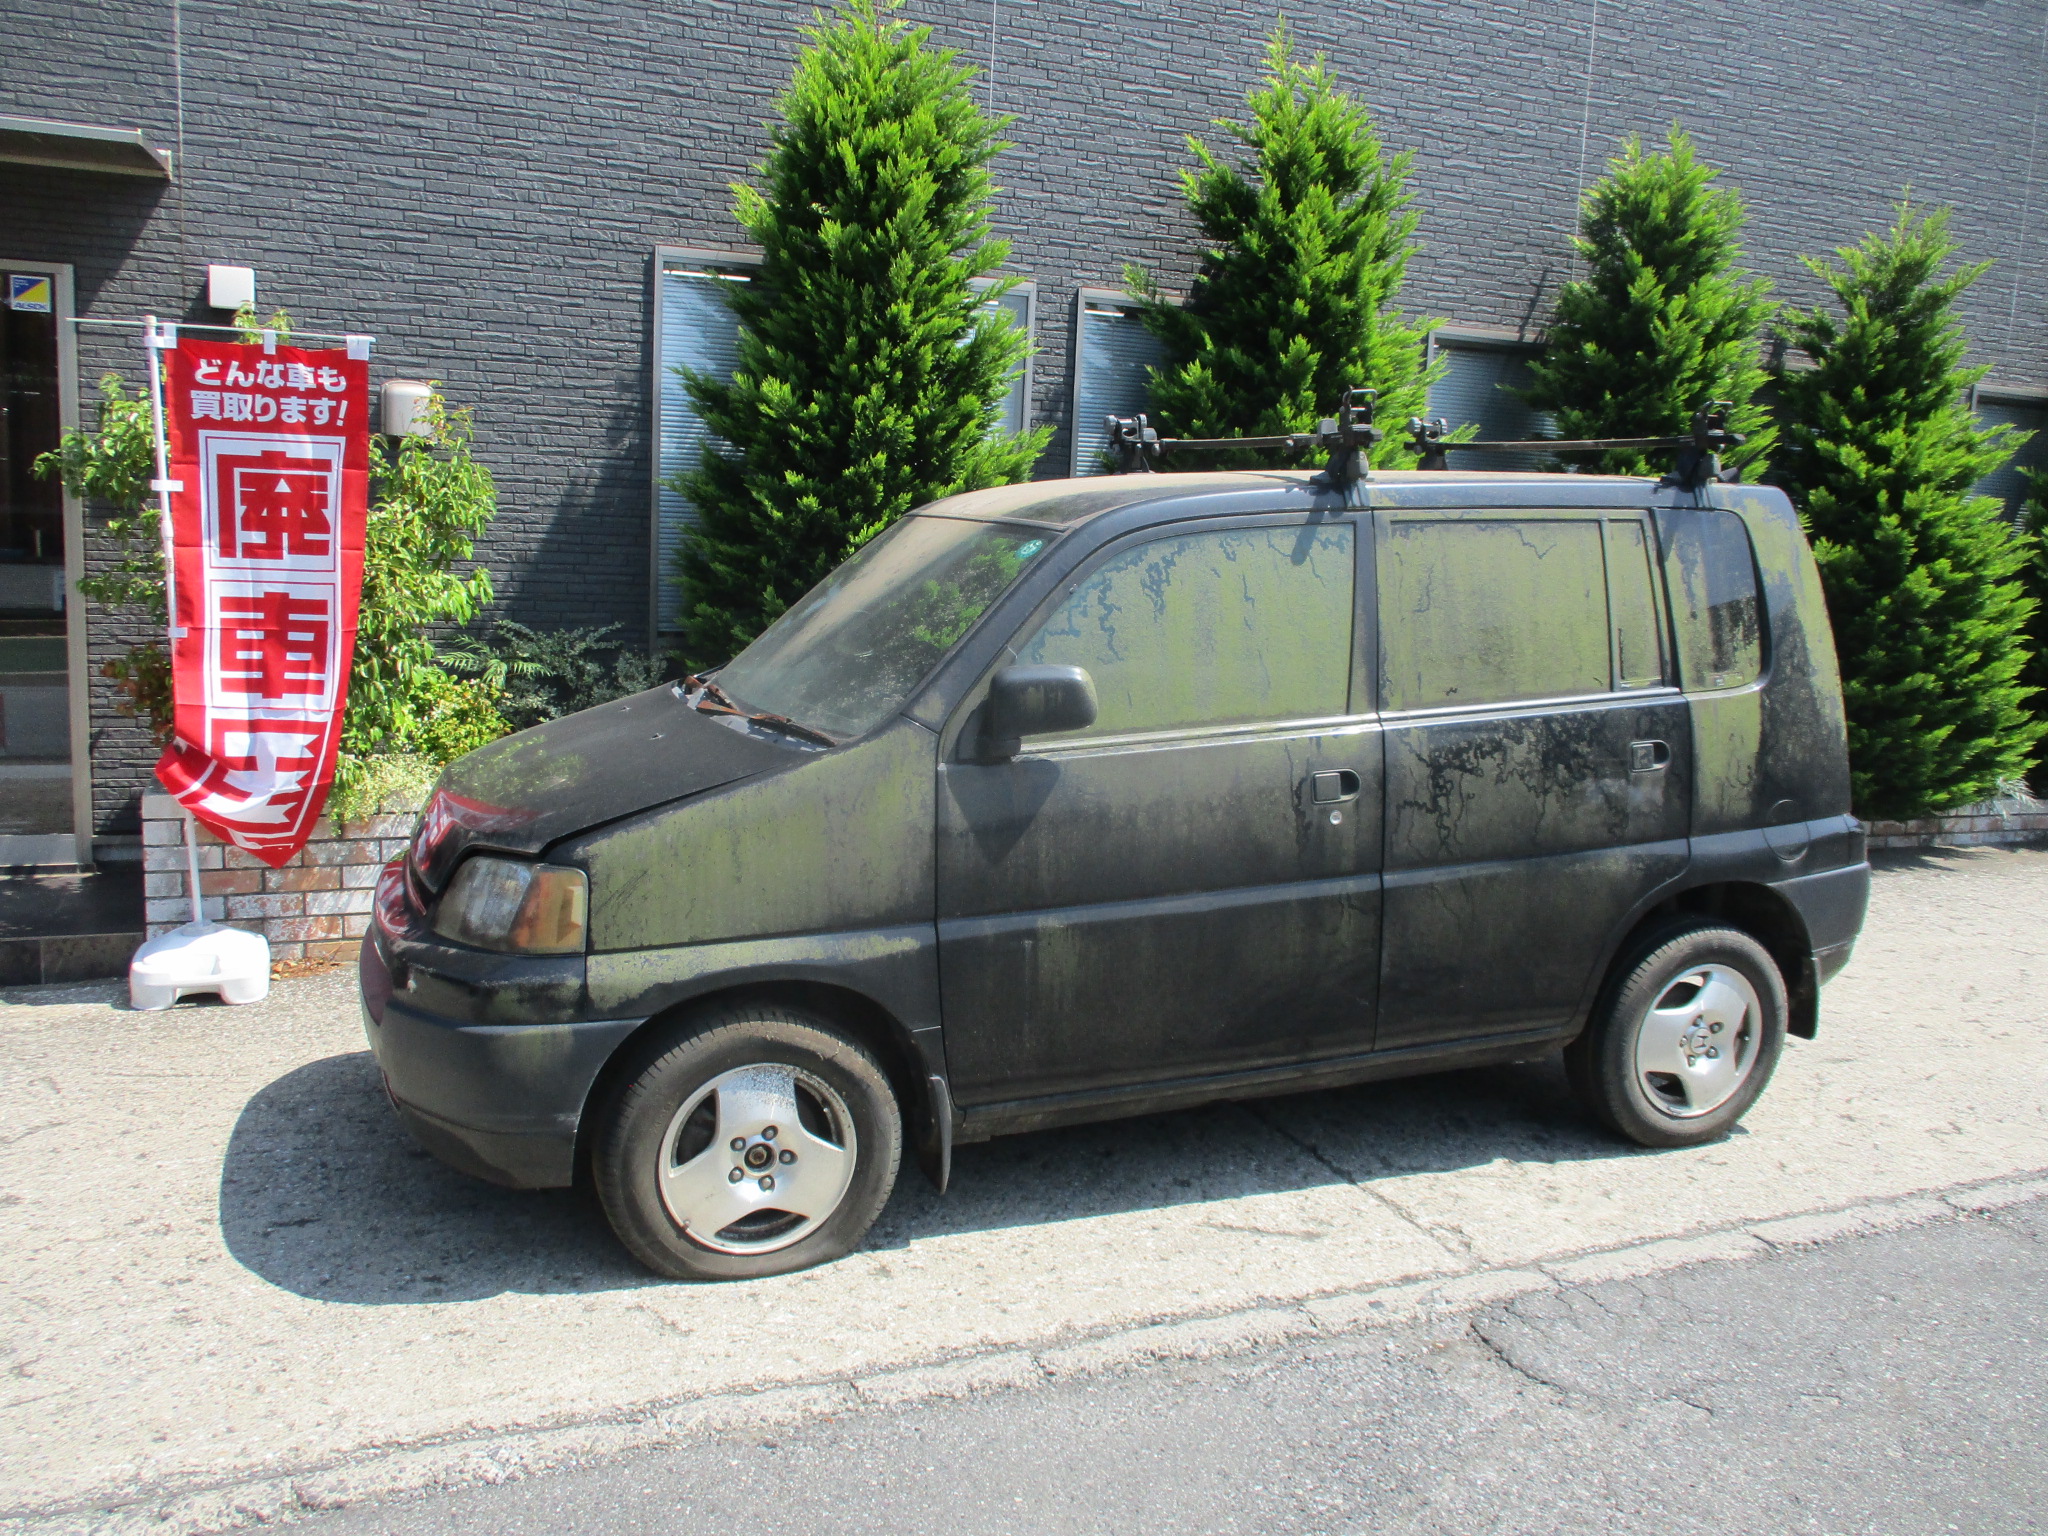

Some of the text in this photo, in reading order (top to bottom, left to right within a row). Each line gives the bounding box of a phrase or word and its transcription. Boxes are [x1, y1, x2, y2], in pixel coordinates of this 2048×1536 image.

[194, 359, 347, 392] どんな車も
[190, 390, 349, 427] 買取ります!
